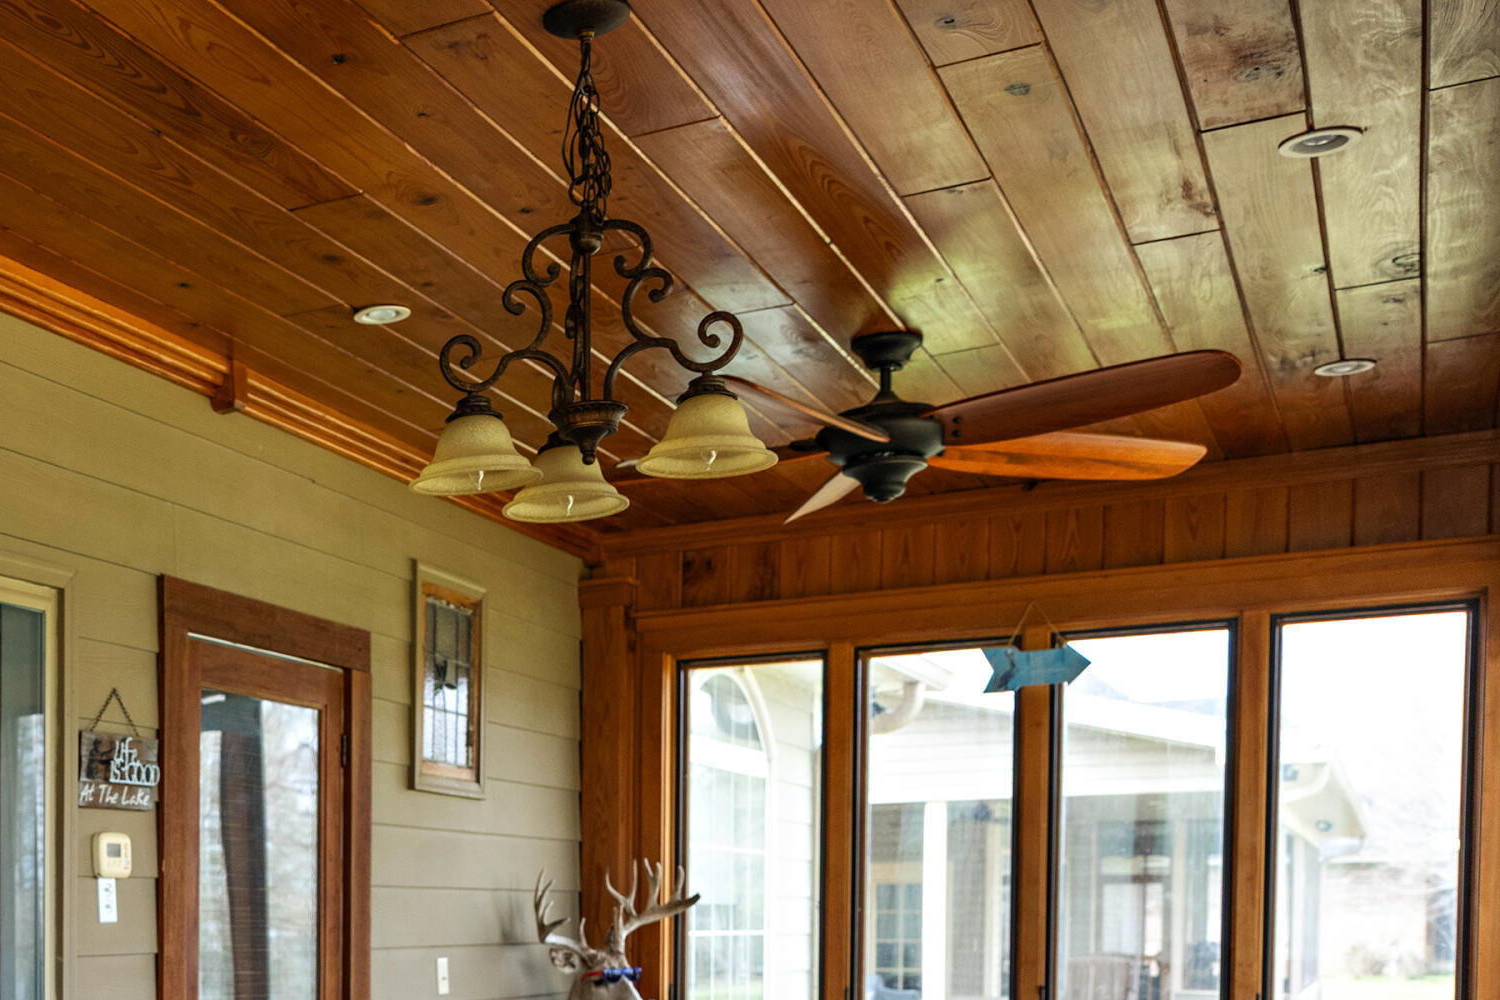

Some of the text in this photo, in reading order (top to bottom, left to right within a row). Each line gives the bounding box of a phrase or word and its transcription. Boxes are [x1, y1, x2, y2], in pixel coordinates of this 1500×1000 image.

[113, 736, 138, 766] Life
[124, 761, 161, 787] GOOD
[80, 783, 95, 802] At
[98, 784, 118, 804] The
